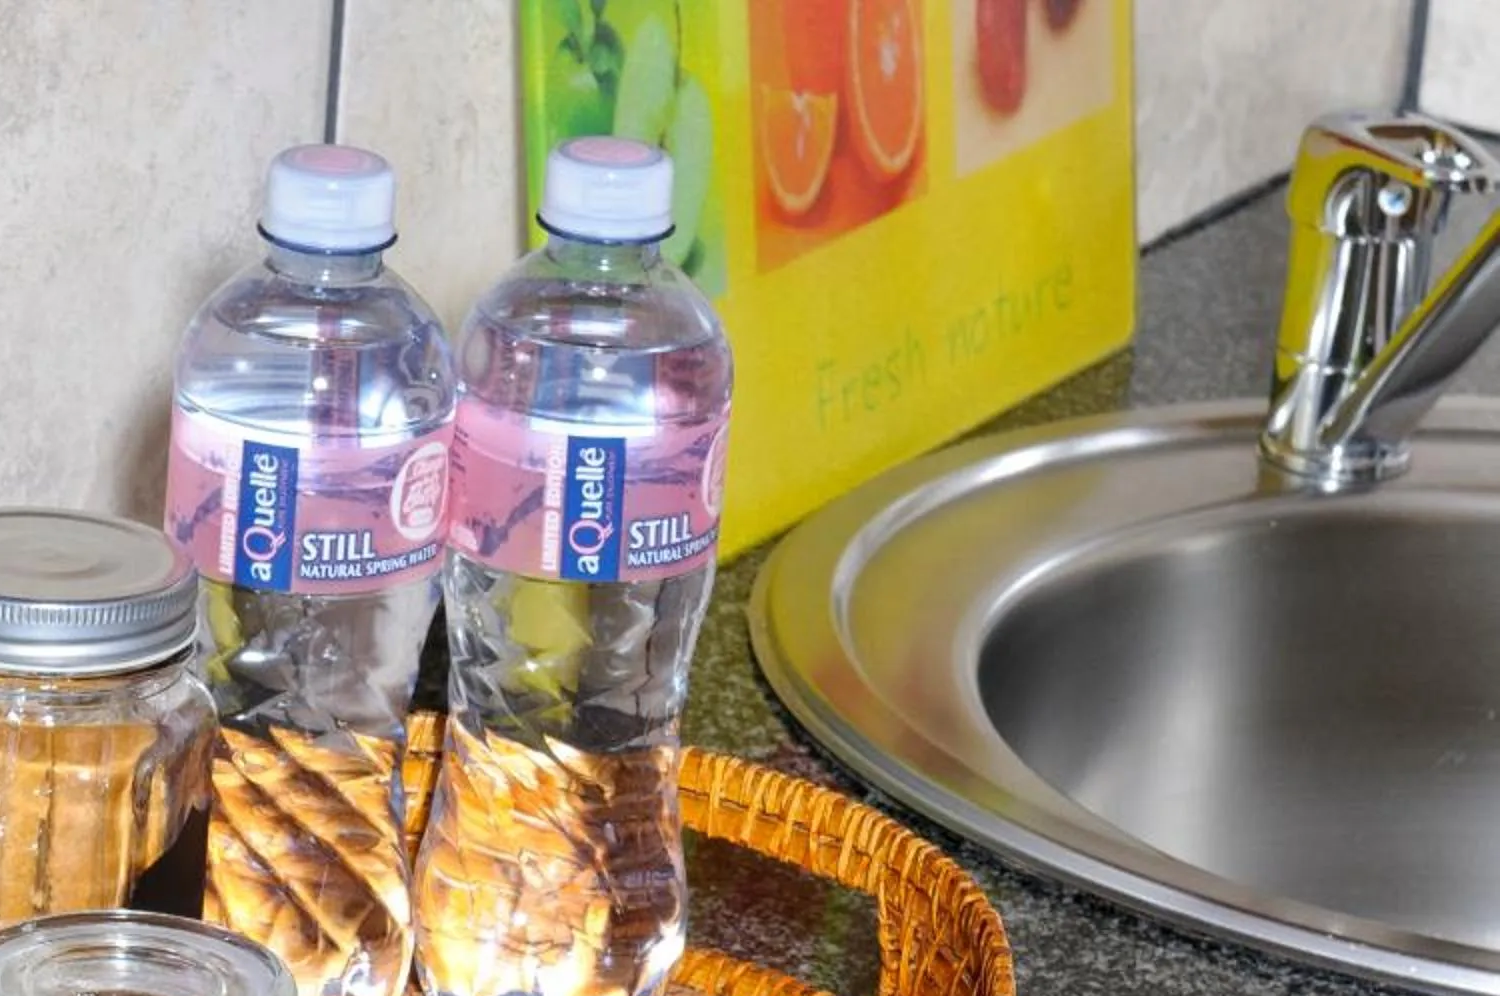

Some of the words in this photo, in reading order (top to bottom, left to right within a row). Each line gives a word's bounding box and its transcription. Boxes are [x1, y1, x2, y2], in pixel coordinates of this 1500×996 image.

[816, 327, 927, 431] Fresh
[946, 264, 1074, 364] nature
[219, 511, 237, 575] LIMITED
[301, 531, 376, 562] STILL
[540, 510, 561, 571] LIMITED
[629, 513, 693, 549] STILL
[300, 562, 363, 578] NATURAL
[366, 554, 407, 576] SPRING
[627, 546, 683, 566] NATURAL
